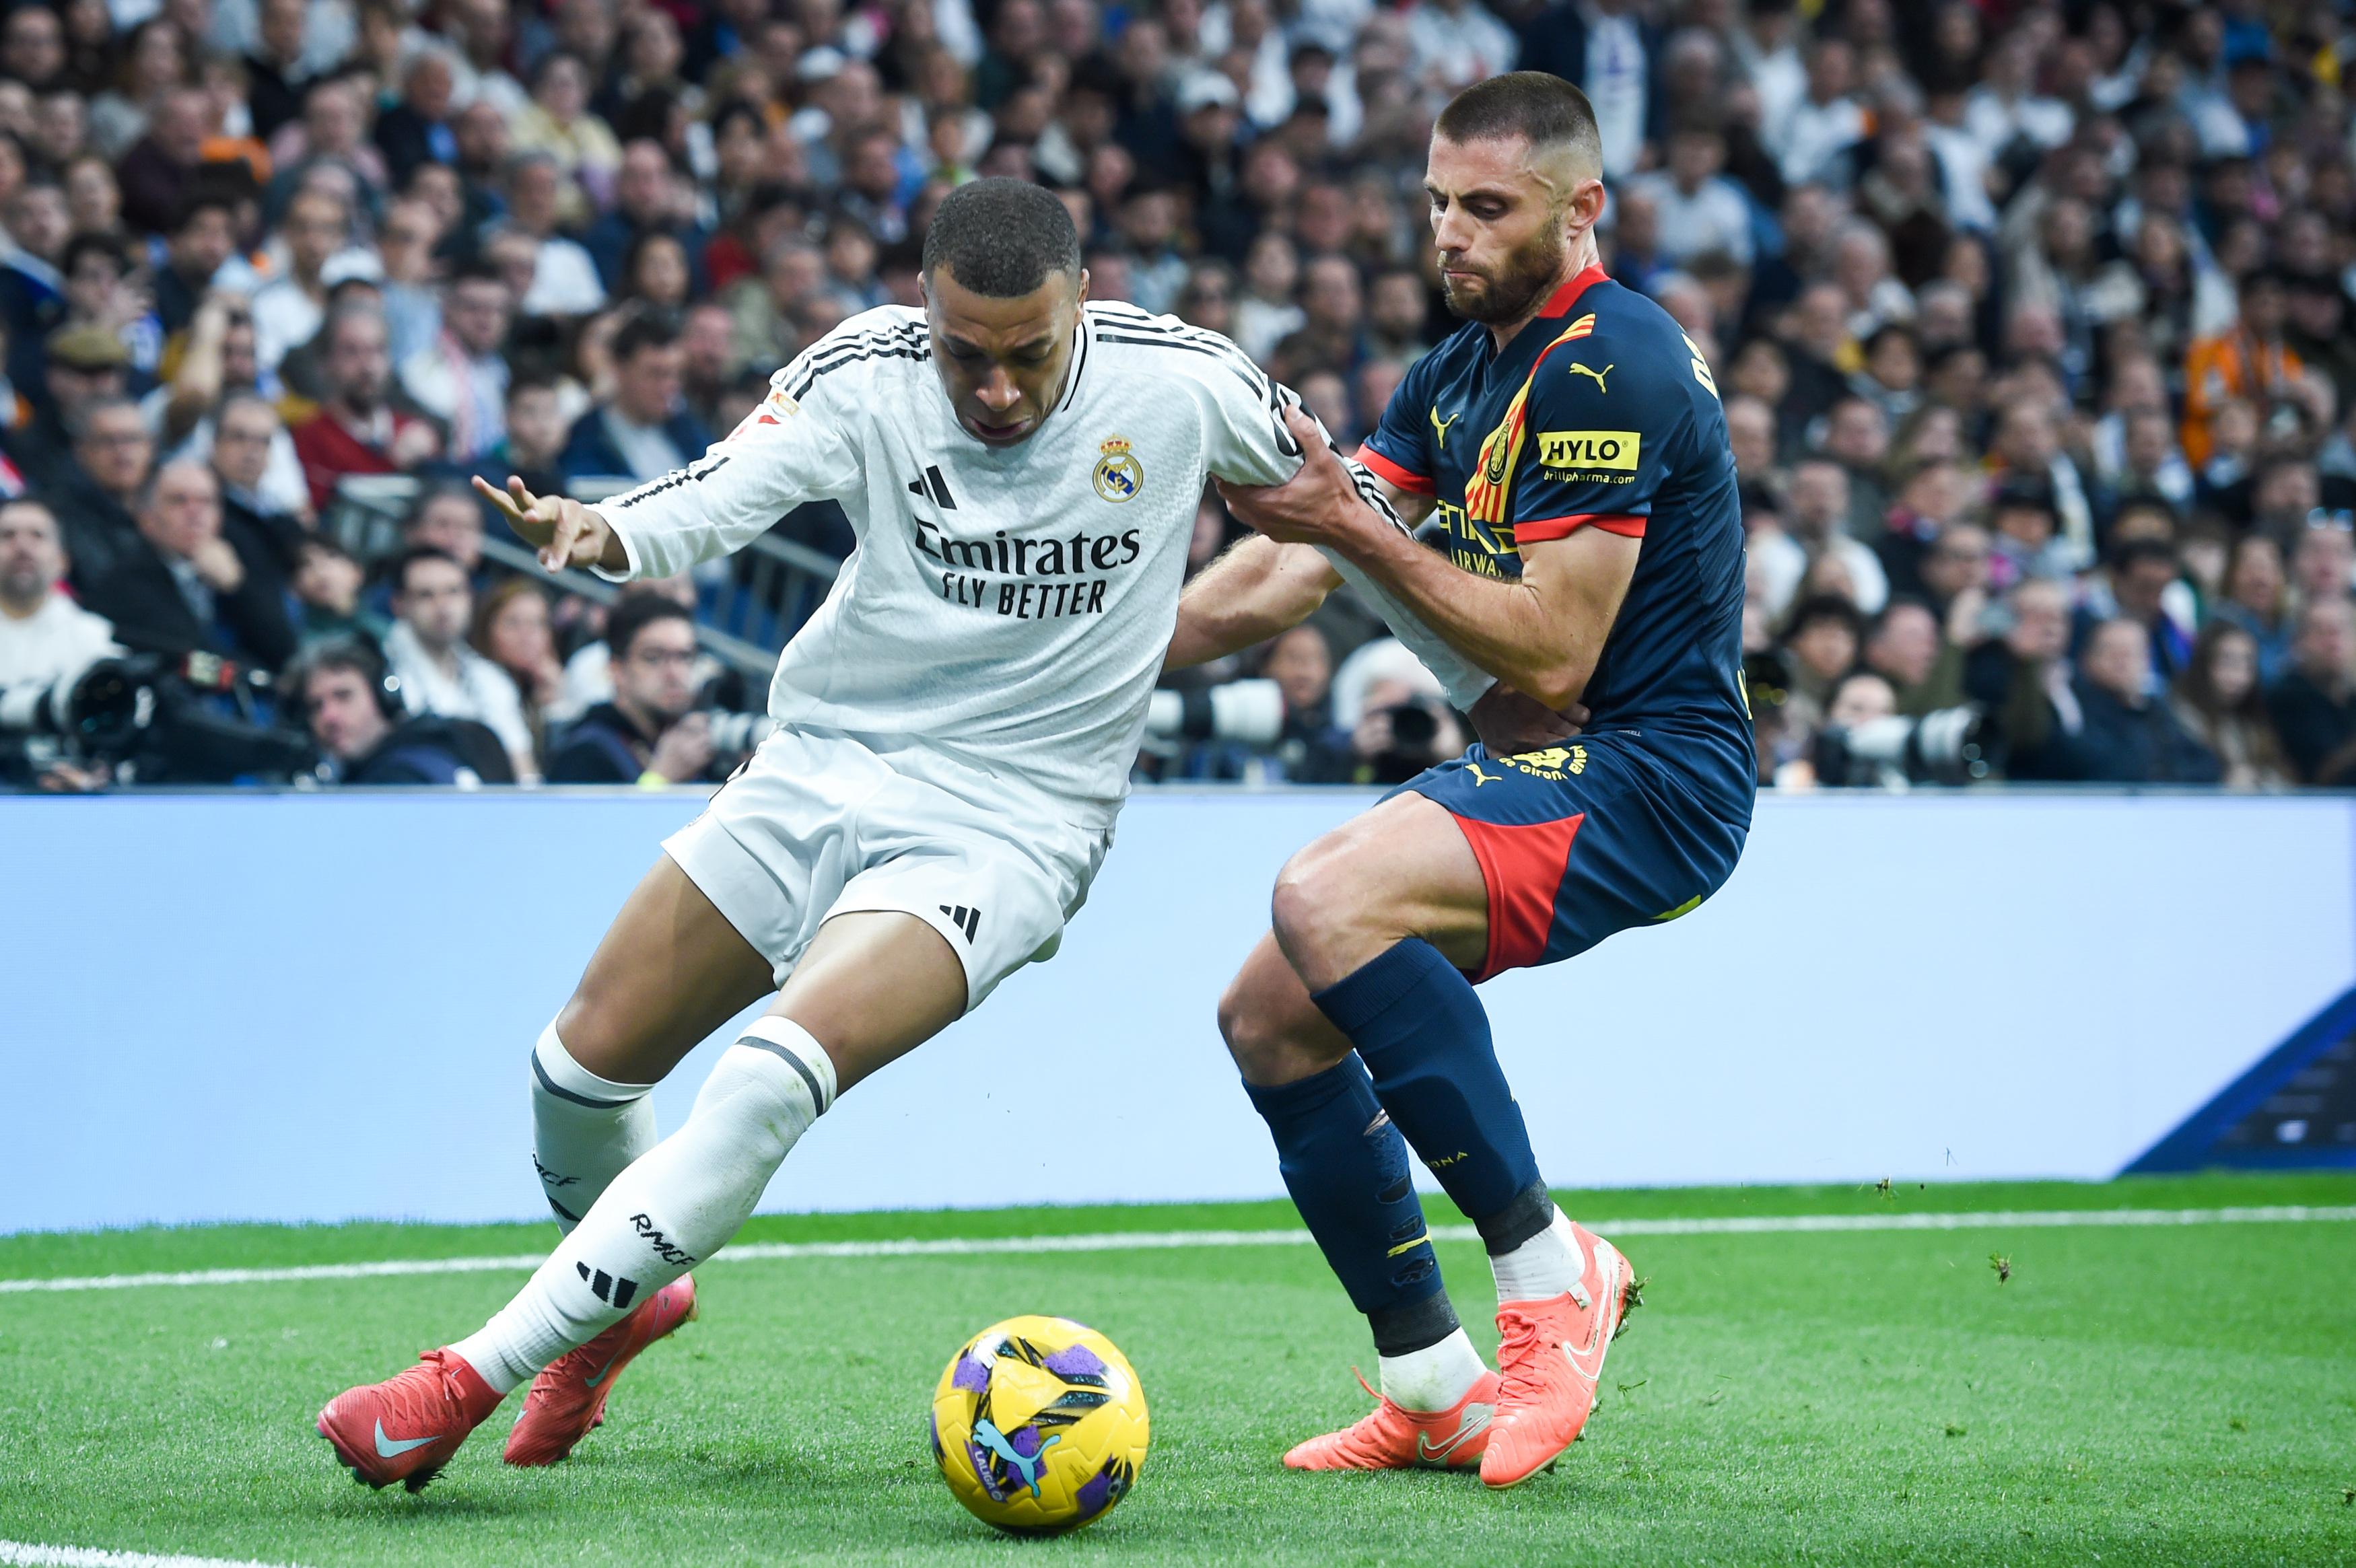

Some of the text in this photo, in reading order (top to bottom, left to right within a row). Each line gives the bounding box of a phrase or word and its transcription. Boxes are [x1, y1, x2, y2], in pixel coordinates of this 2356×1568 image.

[1544, 470, 1636, 484] brillpharma.com
[913, 513, 1140, 575] Emirates
[942, 572, 1107, 619] FLY BETTER
[629, 1213, 696, 1265] RMCF
[975, 1450, 996, 1489] LALIGA
